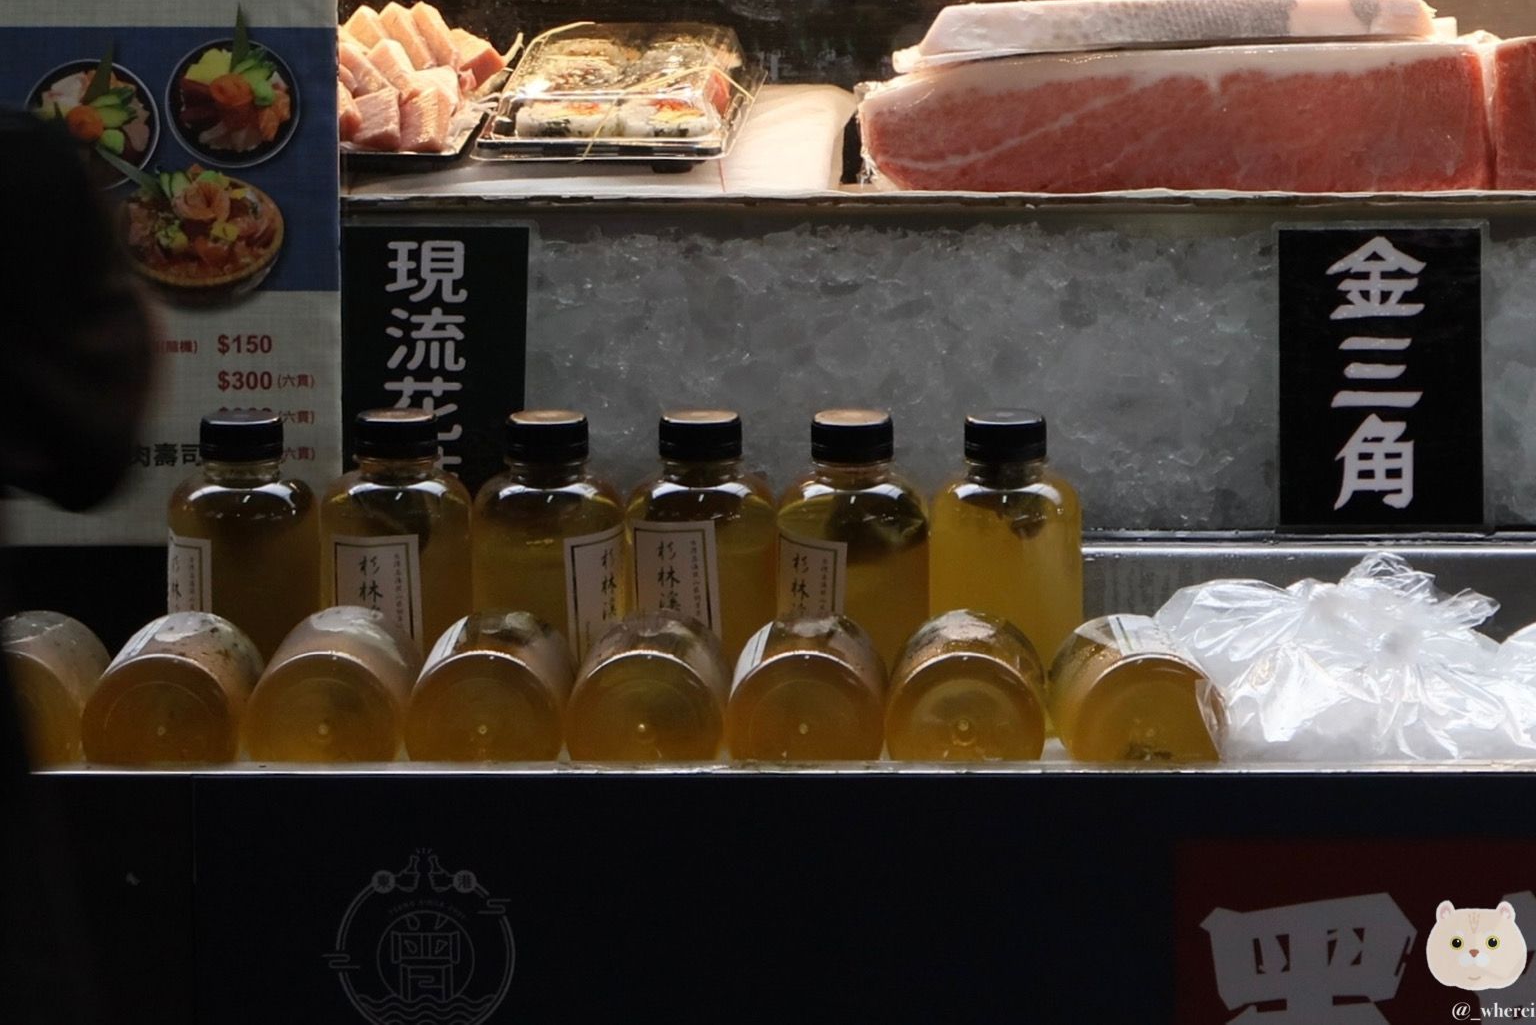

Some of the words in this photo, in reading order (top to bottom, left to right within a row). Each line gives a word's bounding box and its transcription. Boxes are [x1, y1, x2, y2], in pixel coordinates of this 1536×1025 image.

[217, 334, 272, 356] $150
[217, 370, 272, 392] $300
[1324, 235, 1427, 511] 金三角
